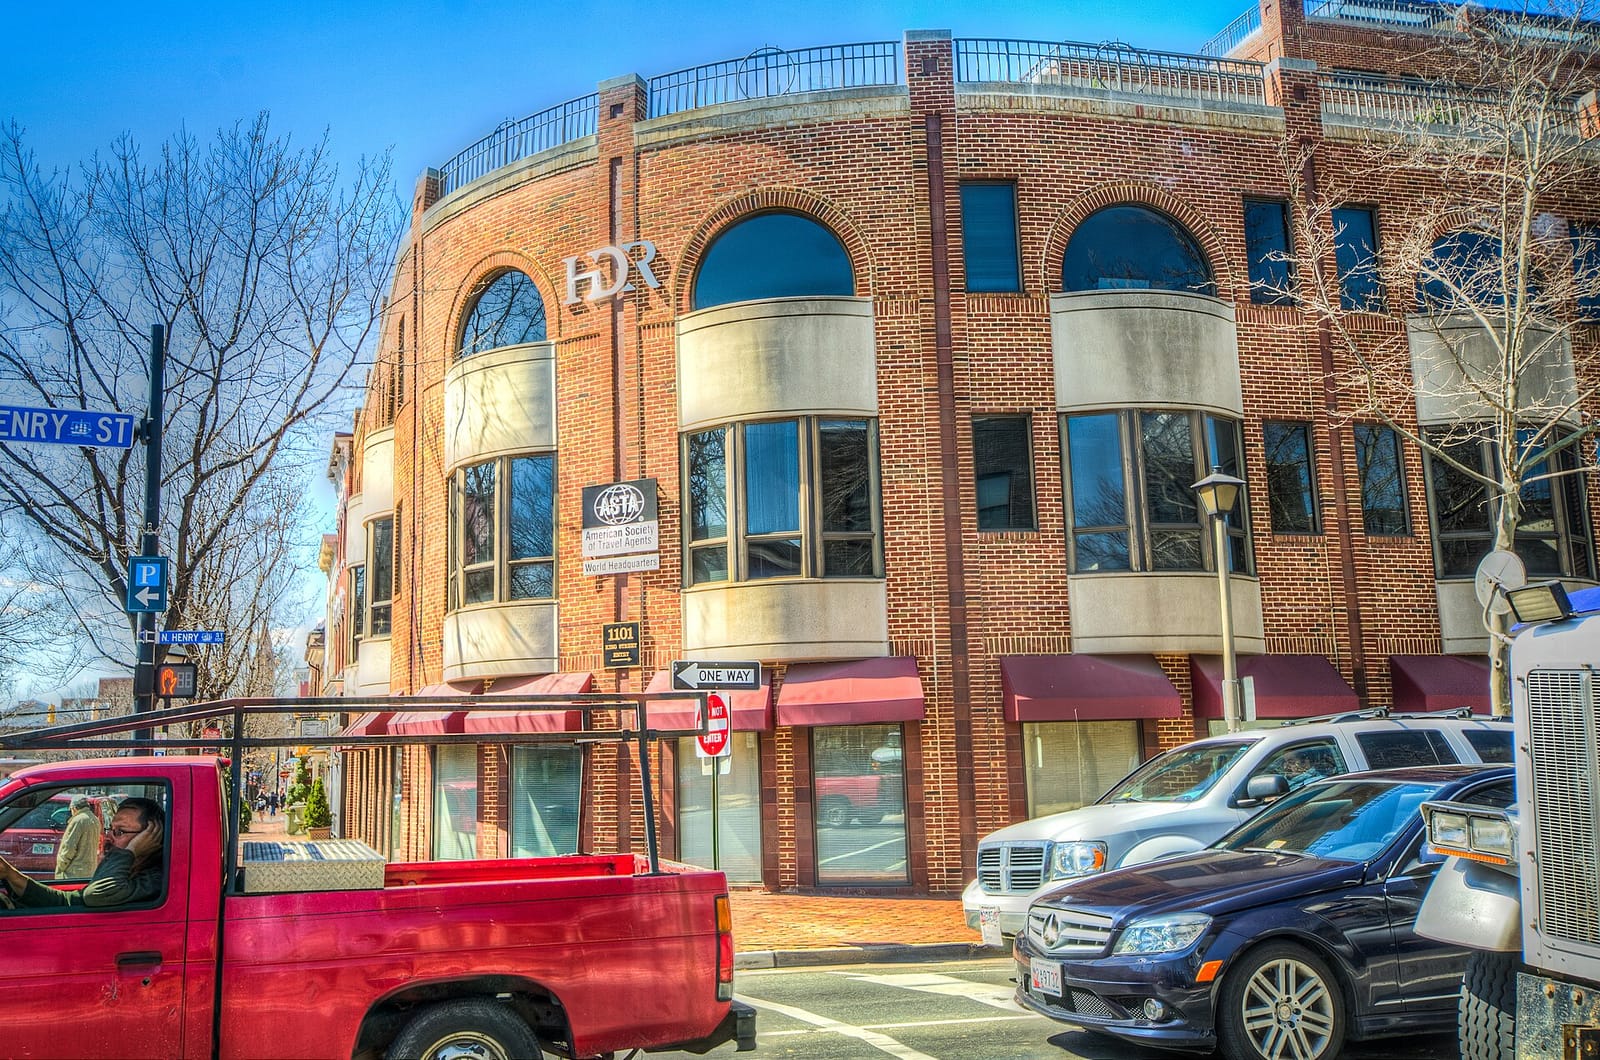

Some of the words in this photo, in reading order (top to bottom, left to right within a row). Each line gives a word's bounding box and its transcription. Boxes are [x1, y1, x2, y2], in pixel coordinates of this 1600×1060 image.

[561, 240, 661, 304] HDR
[96, 416, 130, 444] ST
[599, 493, 640, 517] ASTA
[585, 528, 623, 541] American
[624, 524, 655, 537] Society
[588, 542, 596, 551] of
[598, 538, 623, 550] Travel
[624, 535, 653, 548] Agents
[584, 561, 607, 573] World
[608, 557, 658, 571] Headquarters
[139, 564, 157, 585] P
[161, 633, 170, 642] N.
[171, 633, 199, 642] HENRY
[608, 627, 634, 641] 1101
[699, 670, 722, 682] ONE
[726, 670, 751, 682] WAY
[711, 706, 723, 717] NOT
